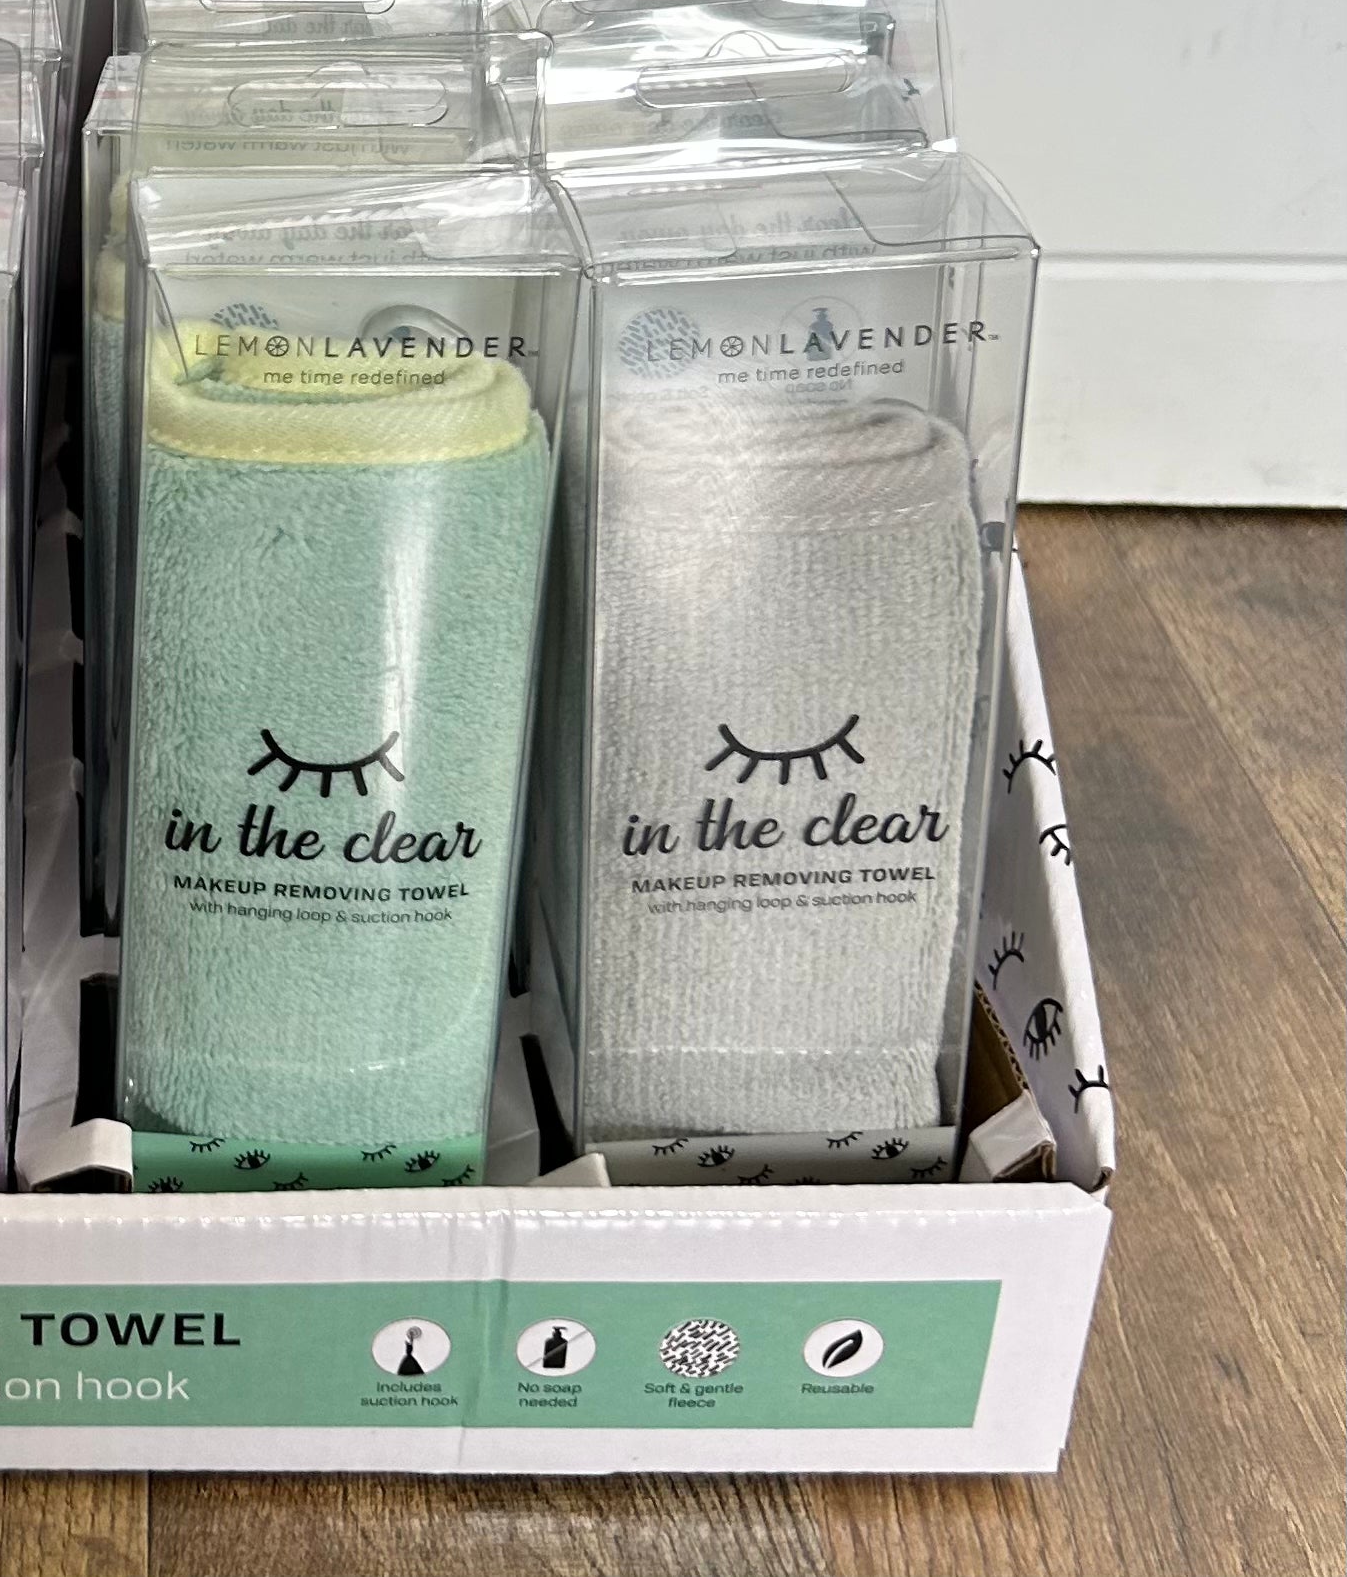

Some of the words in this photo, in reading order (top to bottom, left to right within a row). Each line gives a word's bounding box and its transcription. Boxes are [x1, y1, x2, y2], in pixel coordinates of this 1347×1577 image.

[263, 372, 293, 384] me
[300, 370, 343, 385] time
[351, 369, 446, 386] redefined
[718, 370, 748, 384] me
[756, 364, 800, 382] time
[807, 360, 905, 379] redefined
[165, 808, 221, 853] in
[238, 803, 325, 860] the
[343, 810, 482, 864] clear
[622, 815, 680, 856] in
[696, 798, 785, 850] the
[804, 793, 950, 847] clear
[173, 875, 266, 895] MAKEUP
[274, 884, 391, 902] REMOVING
[399, 884, 470, 901] TOWEL
[631, 876, 726, 894] MAKEUP
[733, 870, 852, 888] REMOVING
[859, 867, 935, 883] TOWEL
[190, 900, 222, 914] with
[227, 903, 292, 921] hanging
[296, 908, 331, 924] loop
[336, 910, 347, 923] &
[352, 909, 410, 924] suction
[414, 908, 452, 923] hook
[647, 900, 683, 914] with
[684, 897, 752, 914] hanging
[756, 895, 791, 911] loop
[796, 894, 808, 907] &
[812, 892, 873, 907] suction
[876, 890, 917, 905] hook
[20, 1312, 242, 1347] TOWEL
[75, 1369, 191, 1401] hook
[376, 1381, 442, 1394] Includes
[518, 1382, 540, 1394] No
[544, 1384, 582, 1397] soap
[644, 1382, 675, 1395] Soft
[679, 1383, 691, 1395] &
[695, 1382, 744, 1397] gentle
[801, 1383, 874, 1395] Reusable
[360, 1396, 417, 1407] suction
[421, 1395, 458, 1407] hook
[518, 1396, 578, 1408] needed
[668, 1396, 716, 1408] fleece
